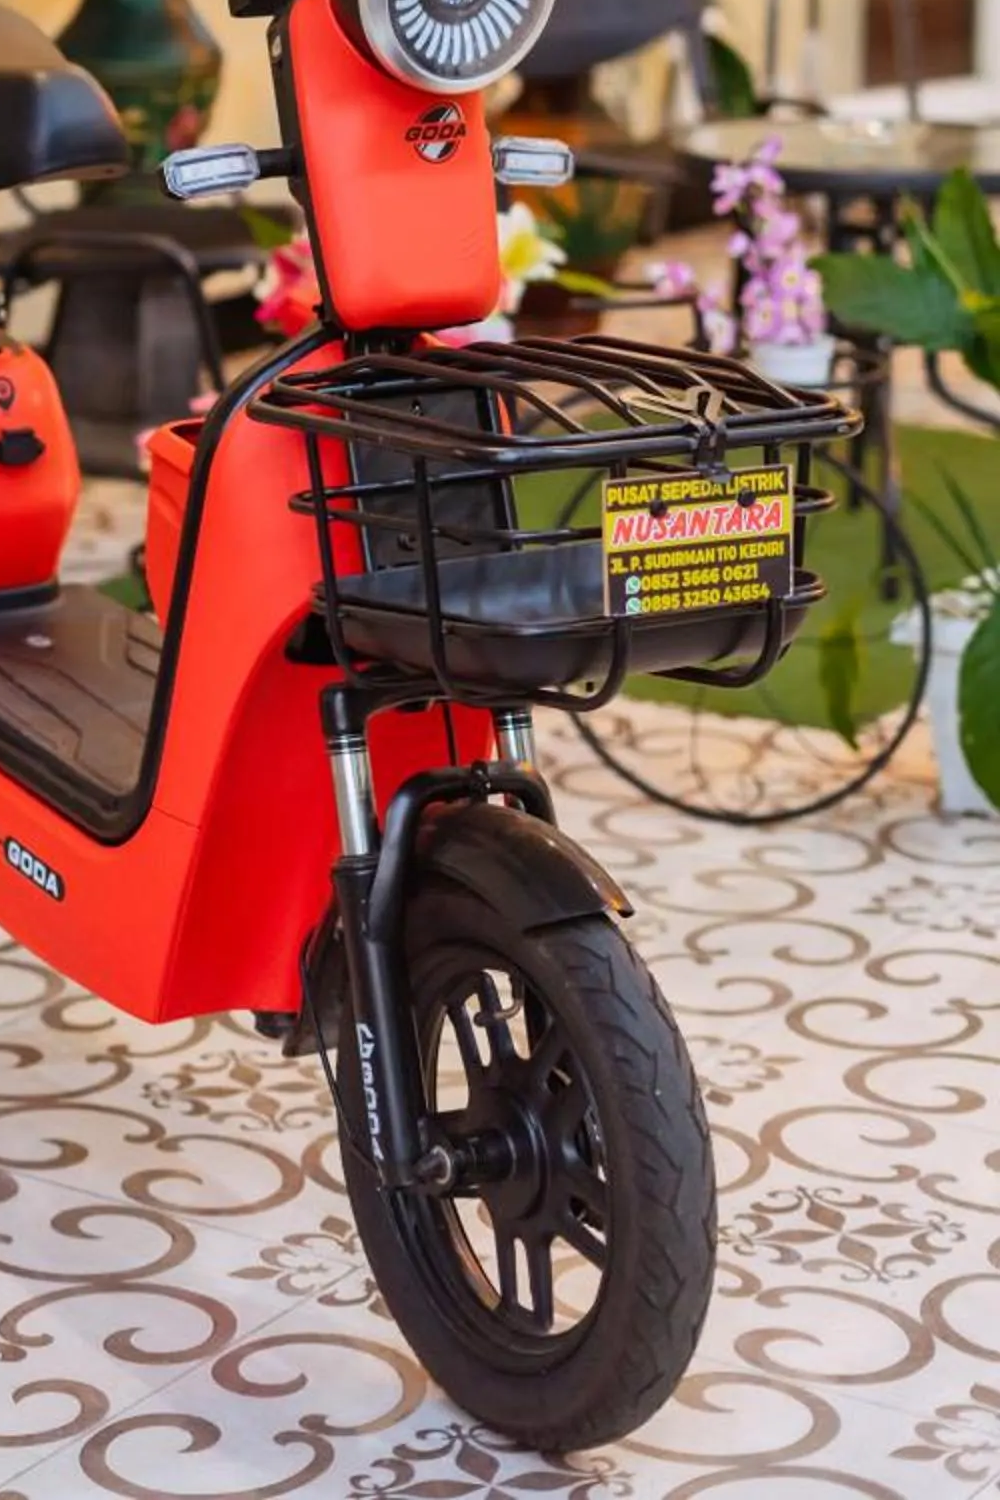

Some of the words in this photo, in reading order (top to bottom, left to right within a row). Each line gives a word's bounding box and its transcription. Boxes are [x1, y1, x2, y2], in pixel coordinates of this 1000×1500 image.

[405, 123, 466, 142] GODA
[607, 484, 659, 506] PUSAT
[661, 480, 724, 500] SEPEDA
[726, 472, 785, 494] LISTRIK
[613, 501, 783, 546] NUSANTARA
[644, 549, 716, 570] SUDIRMAN
[739, 541, 784, 559] KEDIRI
[8, 840, 59, 898] GODA
